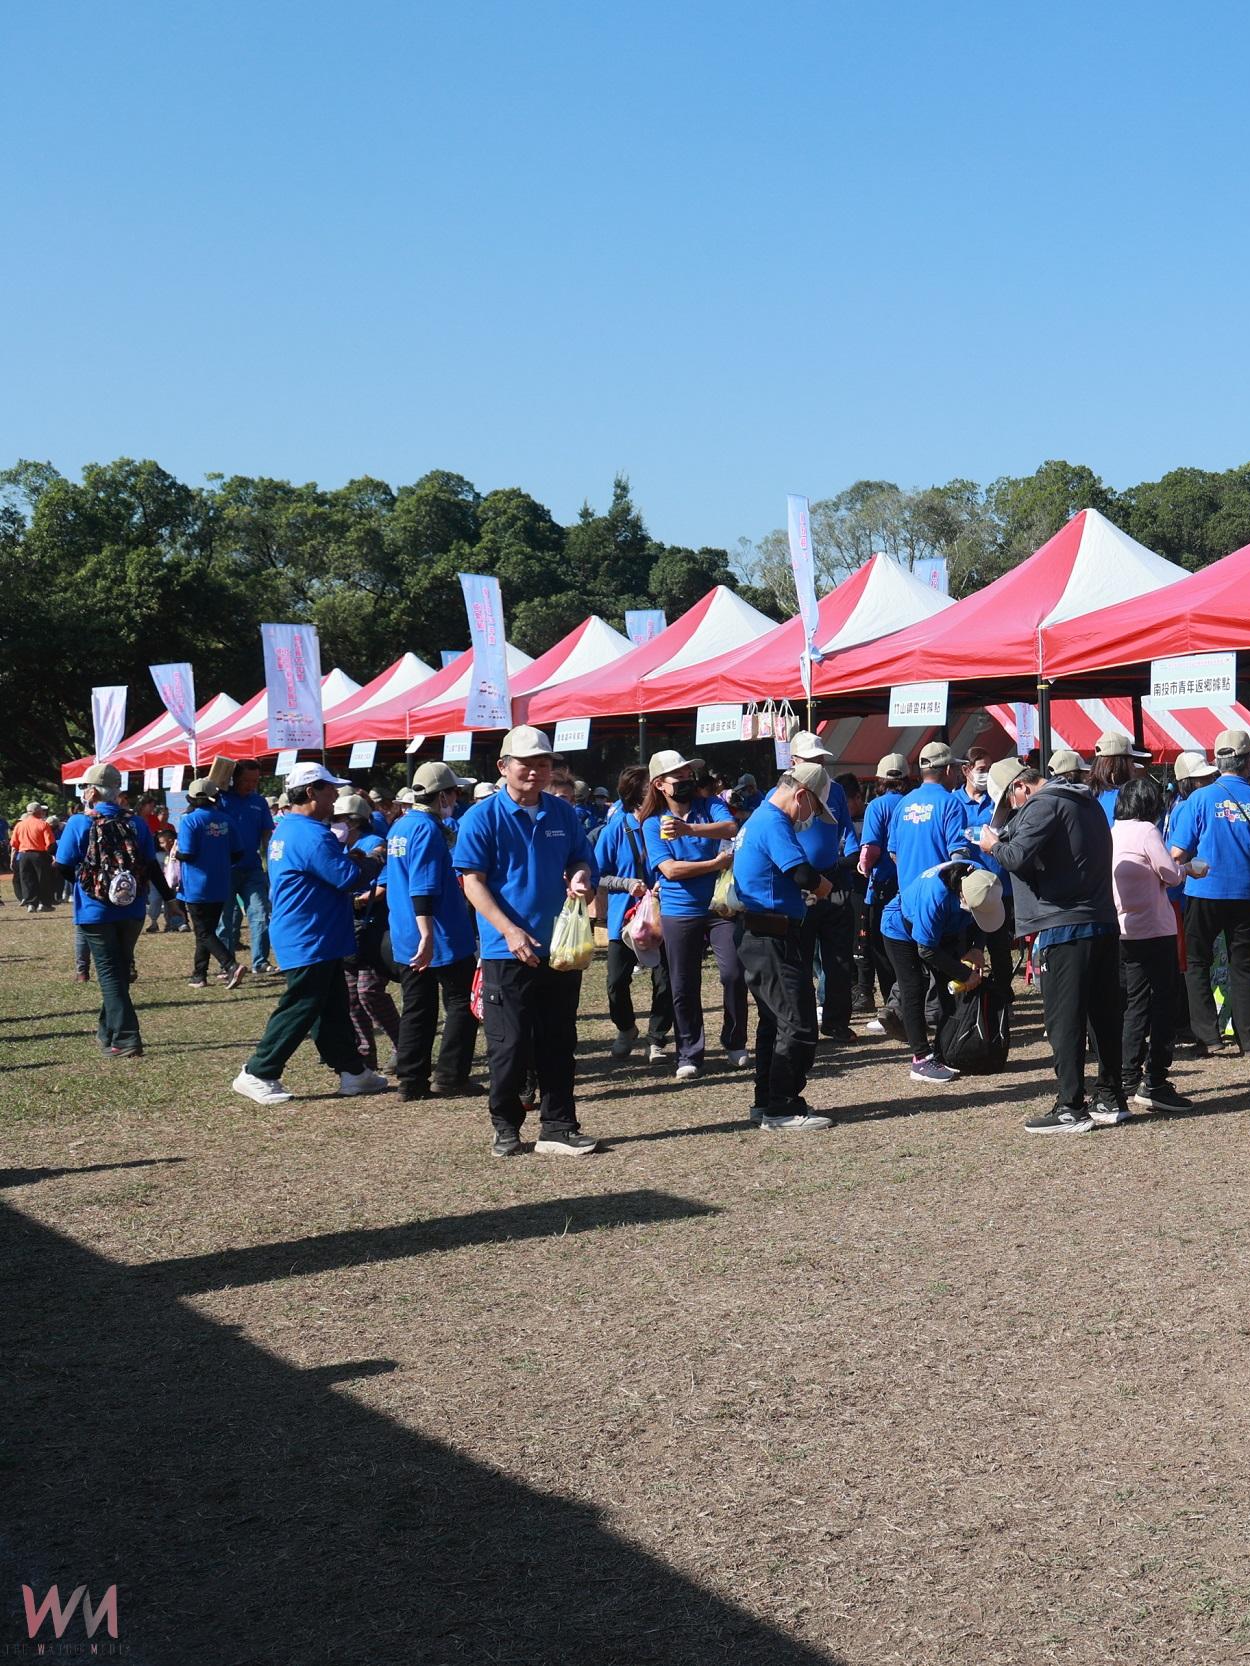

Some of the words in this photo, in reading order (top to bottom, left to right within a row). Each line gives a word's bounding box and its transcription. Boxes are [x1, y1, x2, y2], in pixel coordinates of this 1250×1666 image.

[1154, 677, 1231, 696] 南投市青年返鄉據點
